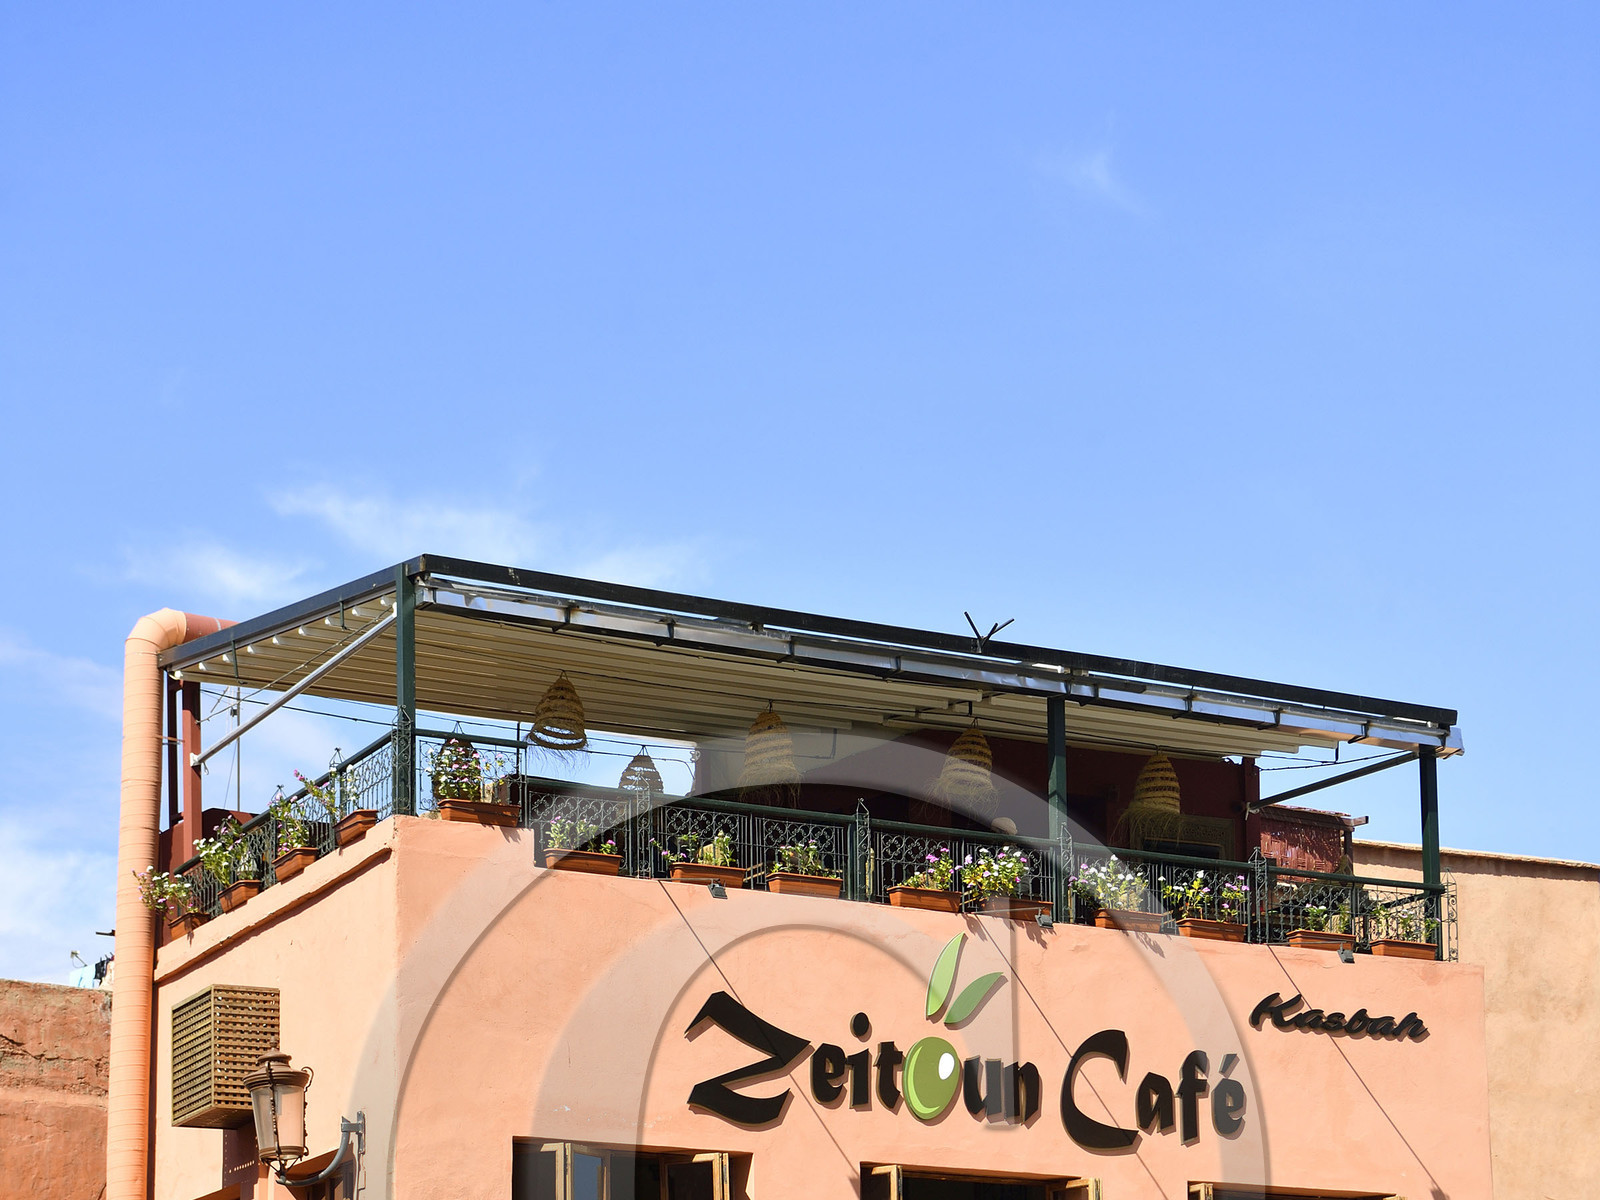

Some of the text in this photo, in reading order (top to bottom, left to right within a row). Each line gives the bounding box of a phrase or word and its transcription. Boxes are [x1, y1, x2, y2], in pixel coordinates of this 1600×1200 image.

[1249, 992, 1428, 1040] Kasbah
[684, 990, 1246, 1150] Zeitoun Café
